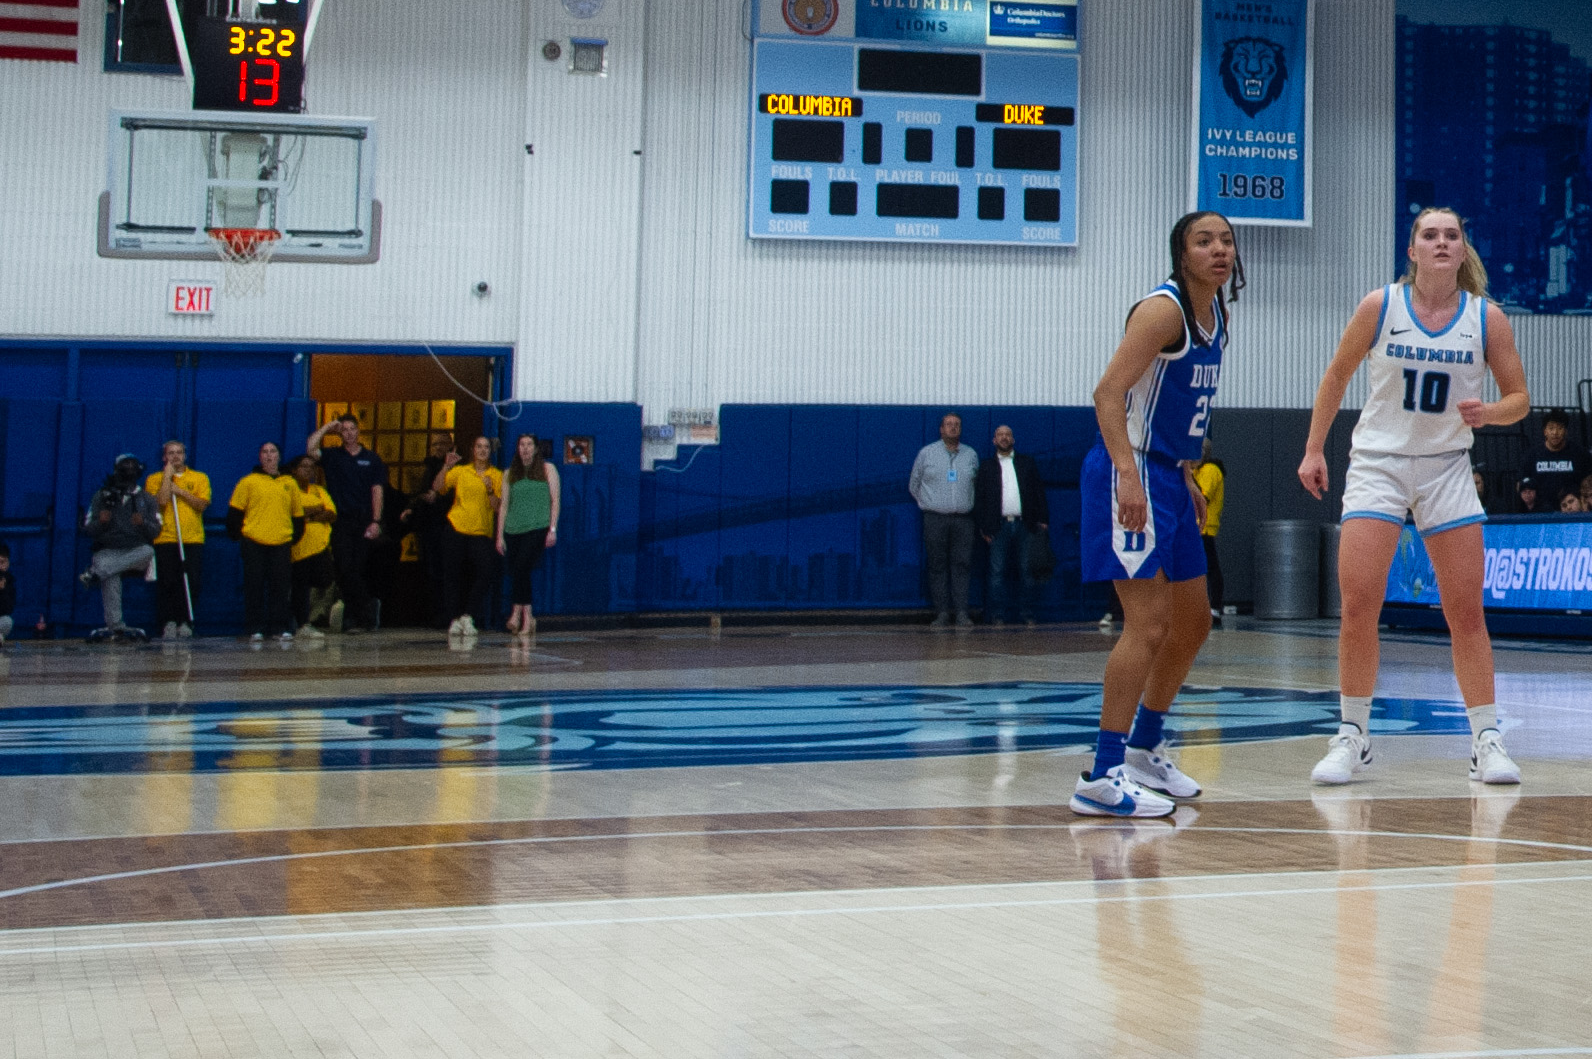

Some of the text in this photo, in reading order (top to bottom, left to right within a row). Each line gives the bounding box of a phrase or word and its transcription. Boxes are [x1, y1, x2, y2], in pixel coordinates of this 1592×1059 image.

[896, 18, 948, 32] LIONS
[1215, 11, 1294, 26] BASKETBALL
[229, 26, 295, 57] 3:22
[238, 58, 280, 107] 13
[767, 94, 852, 117] COLUMBIA
[897, 111, 941, 124] PERIOD
[1004, 104, 1044, 125] DUKE
[1207, 128, 1296, 144] IVY LEAGUE
[1205, 144, 1298, 160] CHAMPIONS
[771, 165, 812, 179] FOULS
[827, 167, 861, 181] T.O.L.
[876, 169, 961, 185] PLAYER FOUL
[975, 172, 1008, 186] T.O.L.
[1022, 174, 1061, 188] FOULS
[1218, 173, 1285, 200] 1968
[768, 220, 809, 234] SCORE
[895, 223, 939, 237] MATCH
[1022, 227, 1061, 241] SCORE
[174, 286, 213, 312] EXIT
[1386, 343, 1474, 365] COLUMBIA
[1403, 368, 1451, 414] 10
[1188, 394, 1217, 437] 2
[1536, 460, 1574, 473] COLUMBIA
